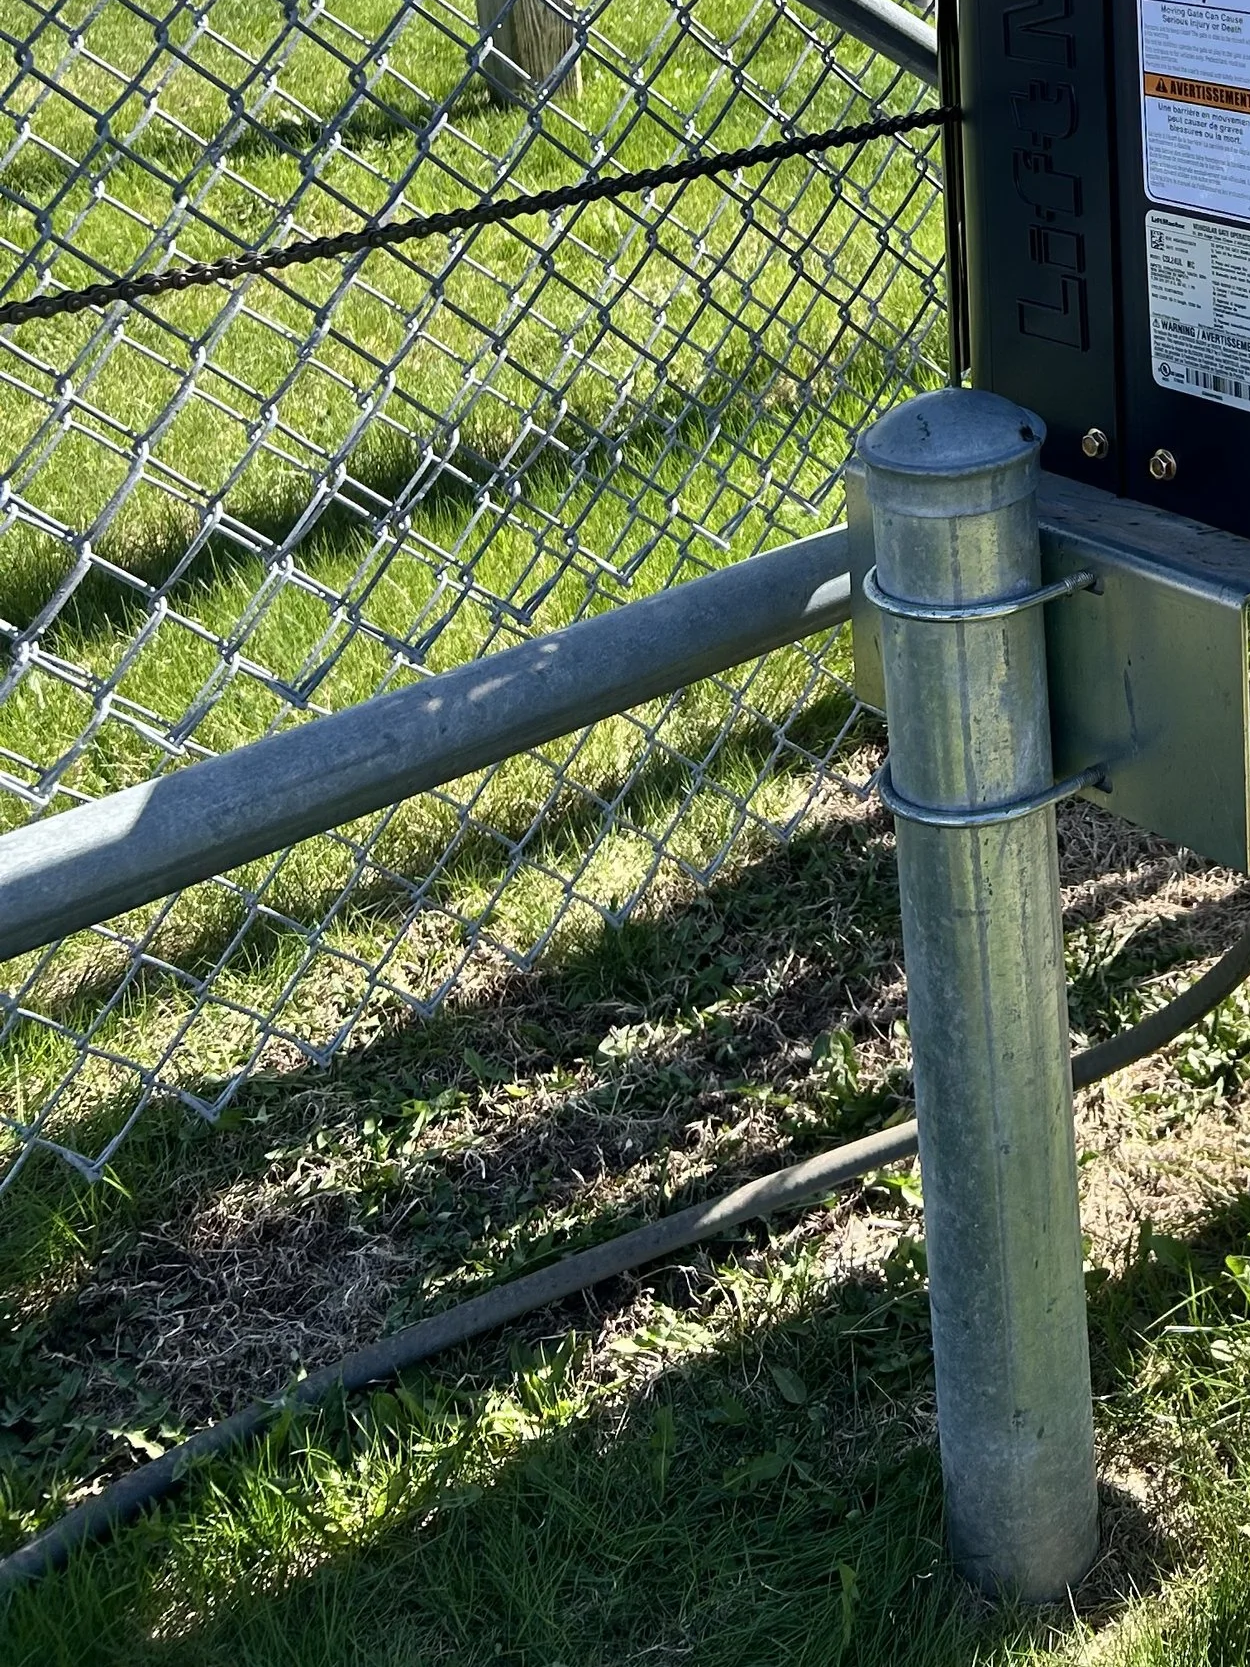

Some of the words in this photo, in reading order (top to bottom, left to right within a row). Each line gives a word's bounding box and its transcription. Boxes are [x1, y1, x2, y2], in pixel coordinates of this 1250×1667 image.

[1160, 4, 1186, 18] Moving
[1187, 9, 1203, 20] Gate
[1205, 11, 1219, 22] Can
[1220, 13, 1243, 24] Cause
[1162, 14, 1189, 26] Serious
[1190, 18, 1211, 31] Injury
[1211, 23, 1220, 31] or
[1221, 22, 1242, 33] Death
[1158, 102, 1172, 112] Une
[1201, 110, 1210, 119] en
[1209, 120, 1218, 130] de
[1204, 130, 1213, 140] ou
[1161, 318, 1195, 338] WARNING
